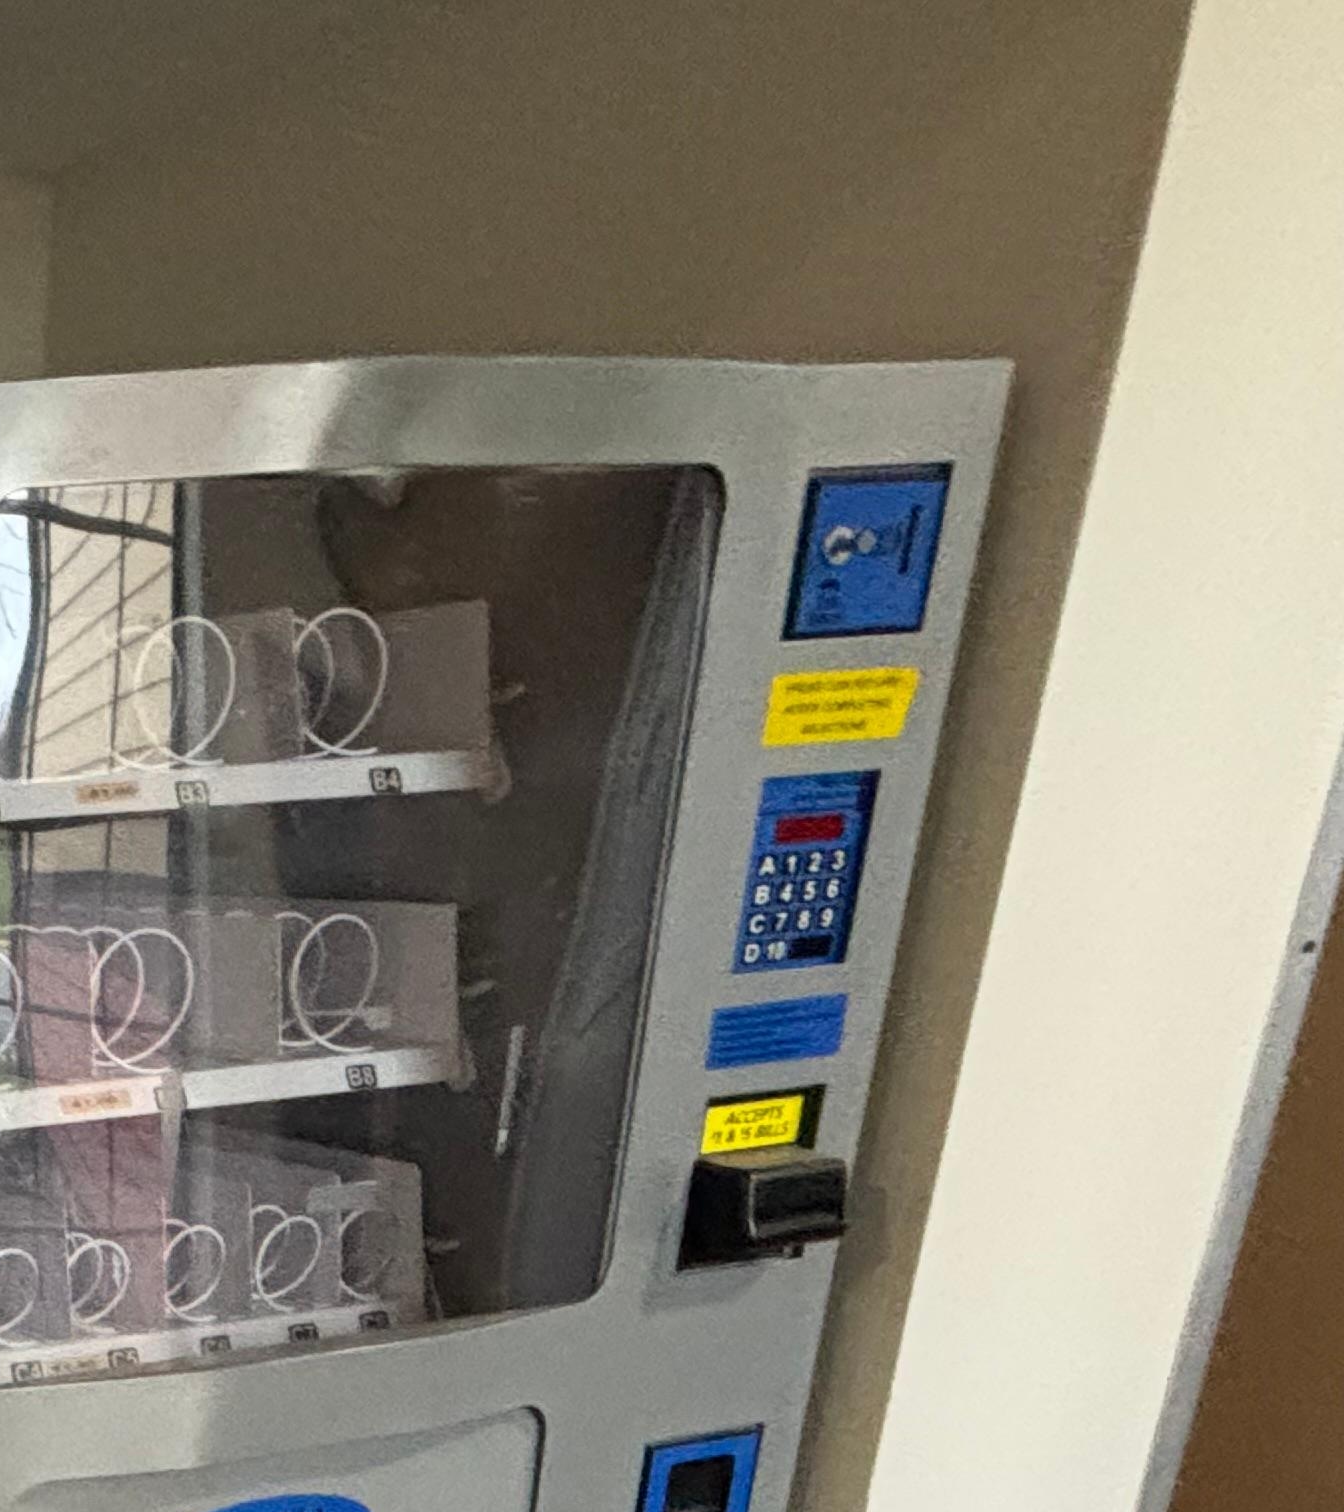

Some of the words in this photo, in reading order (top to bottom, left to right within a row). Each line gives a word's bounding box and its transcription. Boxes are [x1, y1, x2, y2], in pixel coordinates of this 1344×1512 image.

[372, 770, 400, 792] B4
[759, 856, 775, 875] A
[787, 855, 797, 873] 1
[808, 852, 822, 872] 2
[831, 850, 846, 870] 3
[755, 885, 770, 904] B
[780, 884, 793, 902] 4
[803, 881, 817, 900] 5
[827, 879, 840, 898] 6
[749, 914, 765, 933] C
[775, 913, 788, 931] 7
[797, 910, 811, 929] 8
[820, 908, 834, 927] 9
[744, 944, 759, 963] D
[347, 1066, 375, 1088] B8
